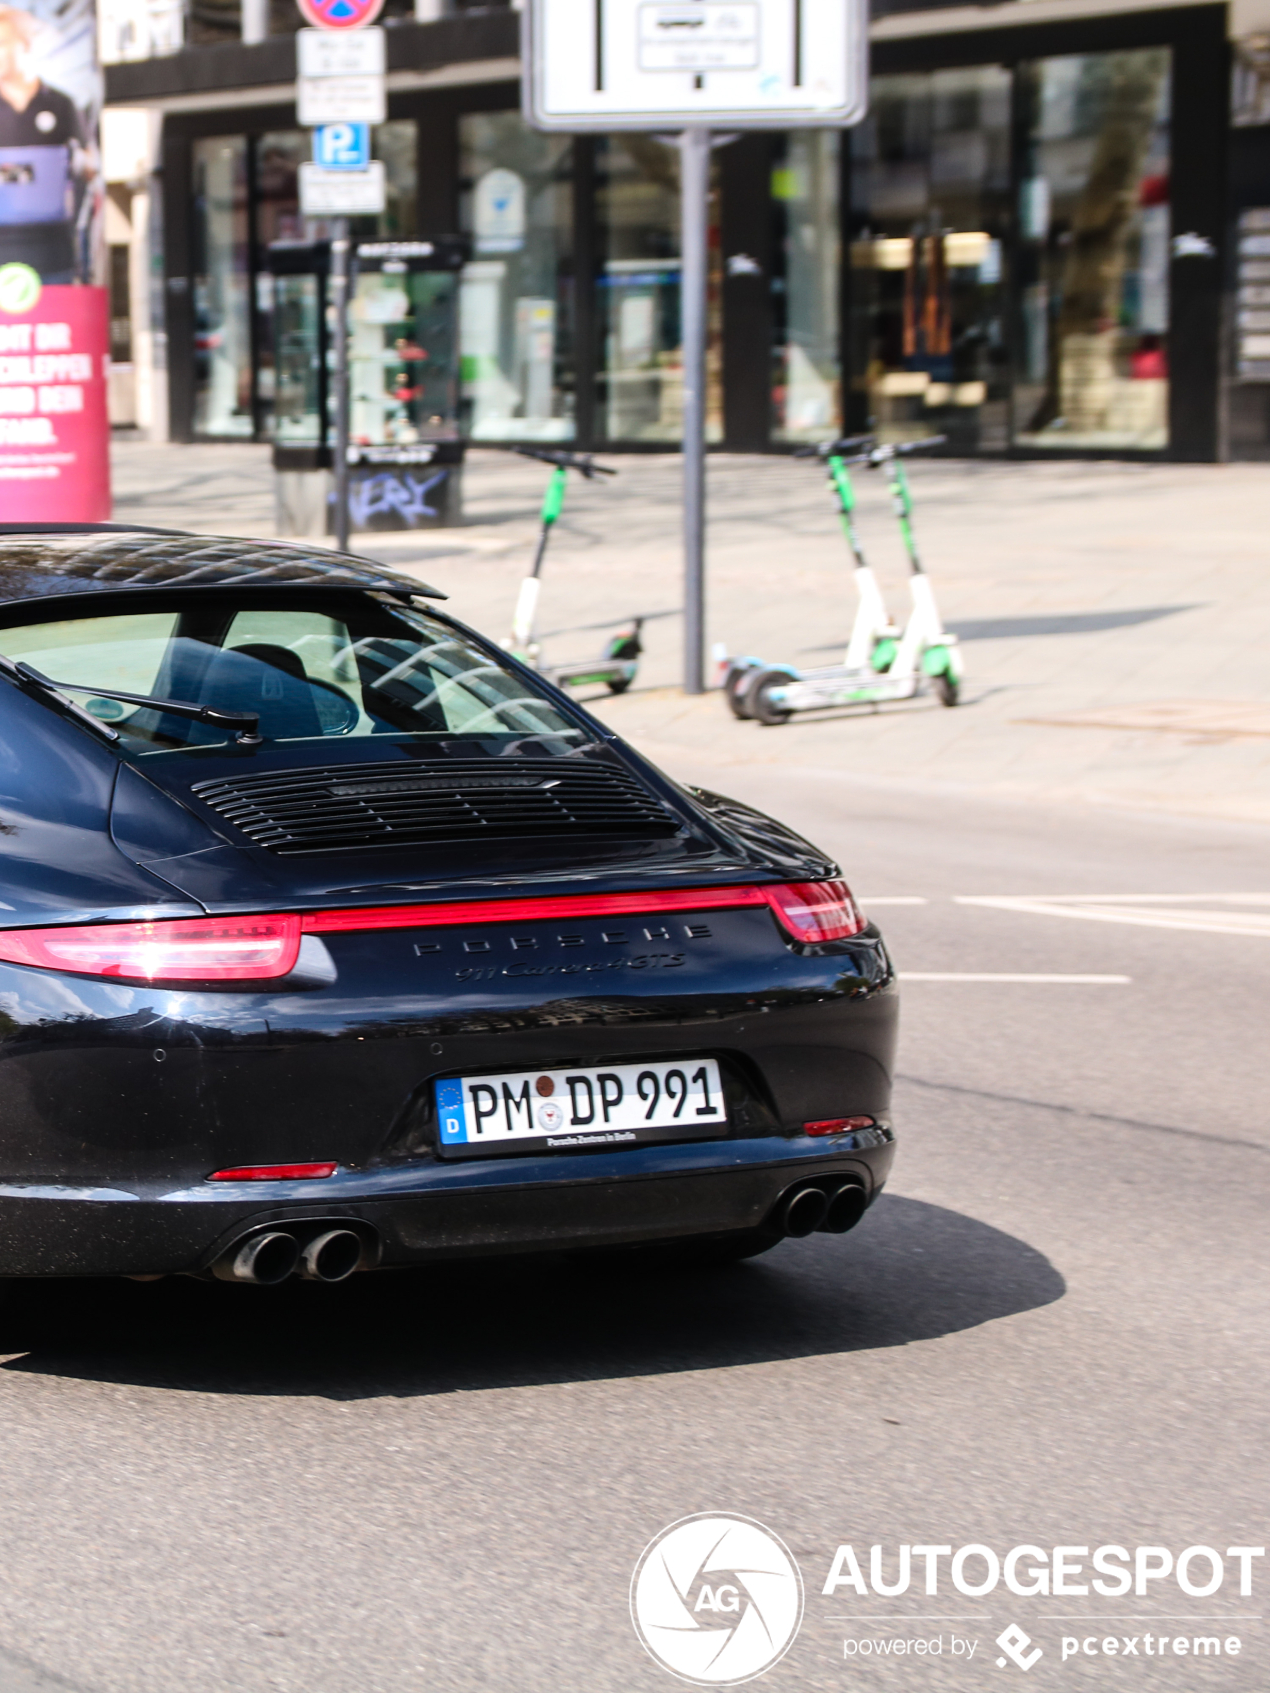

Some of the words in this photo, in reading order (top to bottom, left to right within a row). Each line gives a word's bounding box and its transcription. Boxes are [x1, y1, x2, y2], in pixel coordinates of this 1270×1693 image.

[413, 924, 713, 957] PORSCHE
[455, 964, 498, 982] 911
[501, 961, 604, 978] Carrera
[469, 1079, 534, 1134] PM
[566, 1073, 623, 1125] DP
[636, 1066, 718, 1120] 991
[446, 1118, 460, 1134] D
[547, 1136, 577, 1146] Porsche
[614, 1131, 636, 1141] Berlin
